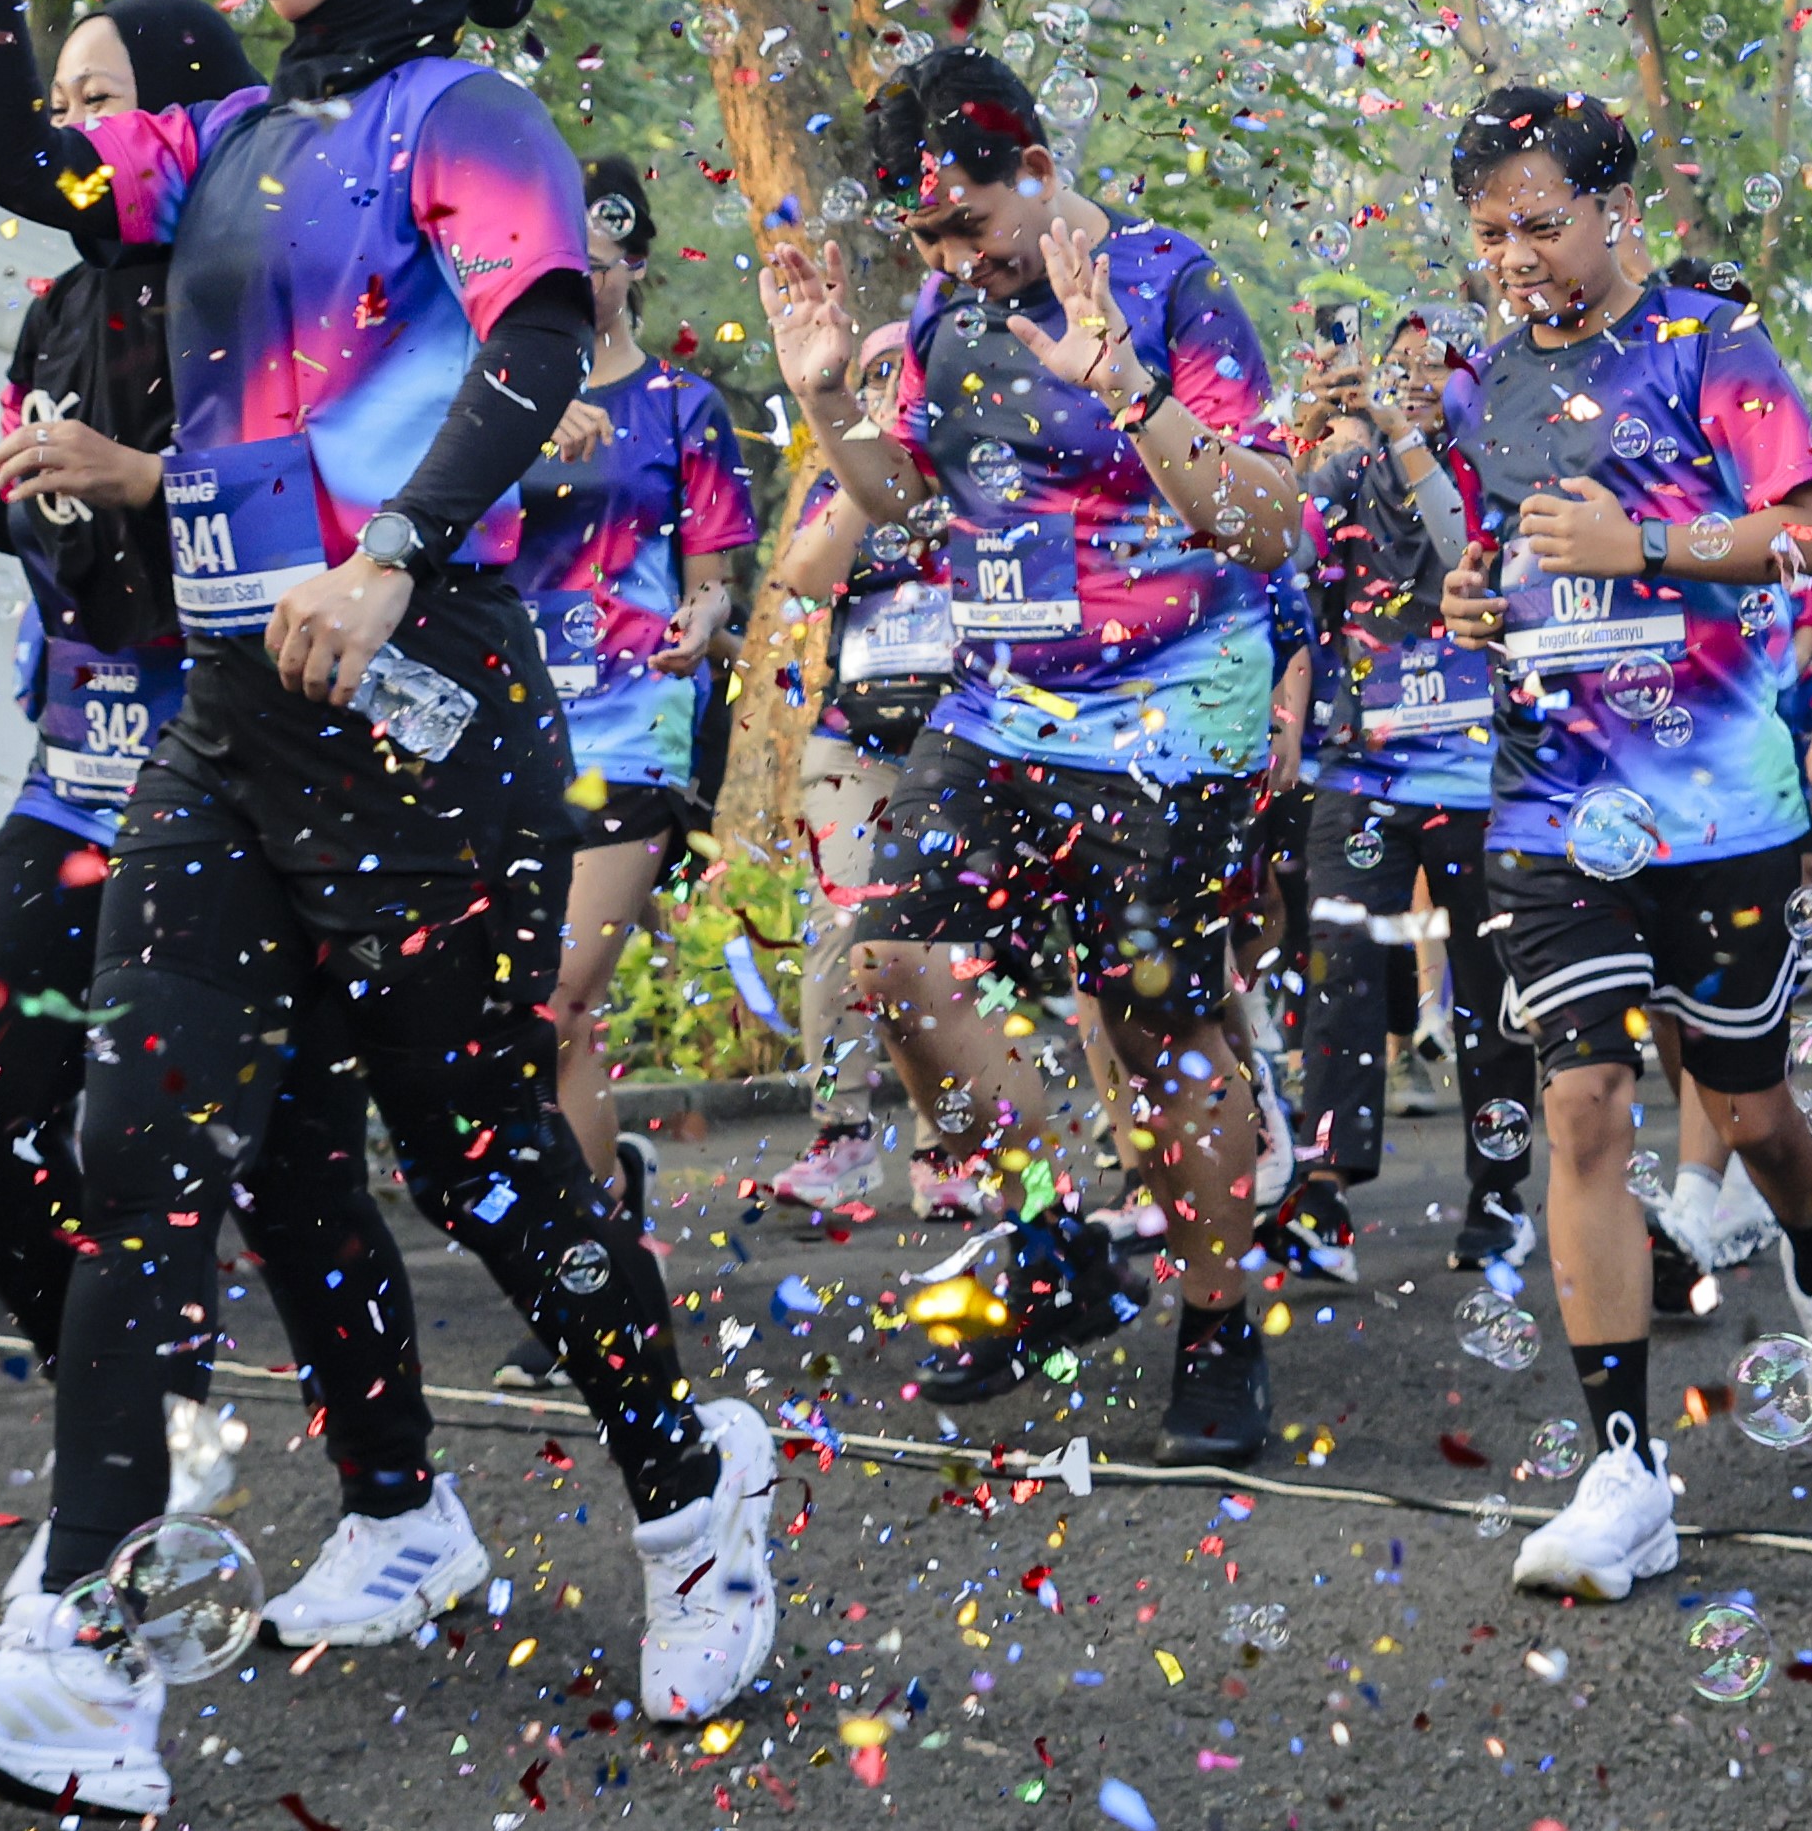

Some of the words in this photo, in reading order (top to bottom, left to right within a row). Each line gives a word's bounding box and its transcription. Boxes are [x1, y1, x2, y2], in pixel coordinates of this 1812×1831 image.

[171, 513, 237, 574] 341
[977, 558, 1024, 601] 021
[1401, 671, 1446, 706] 310
[85, 700, 151, 756] 342
